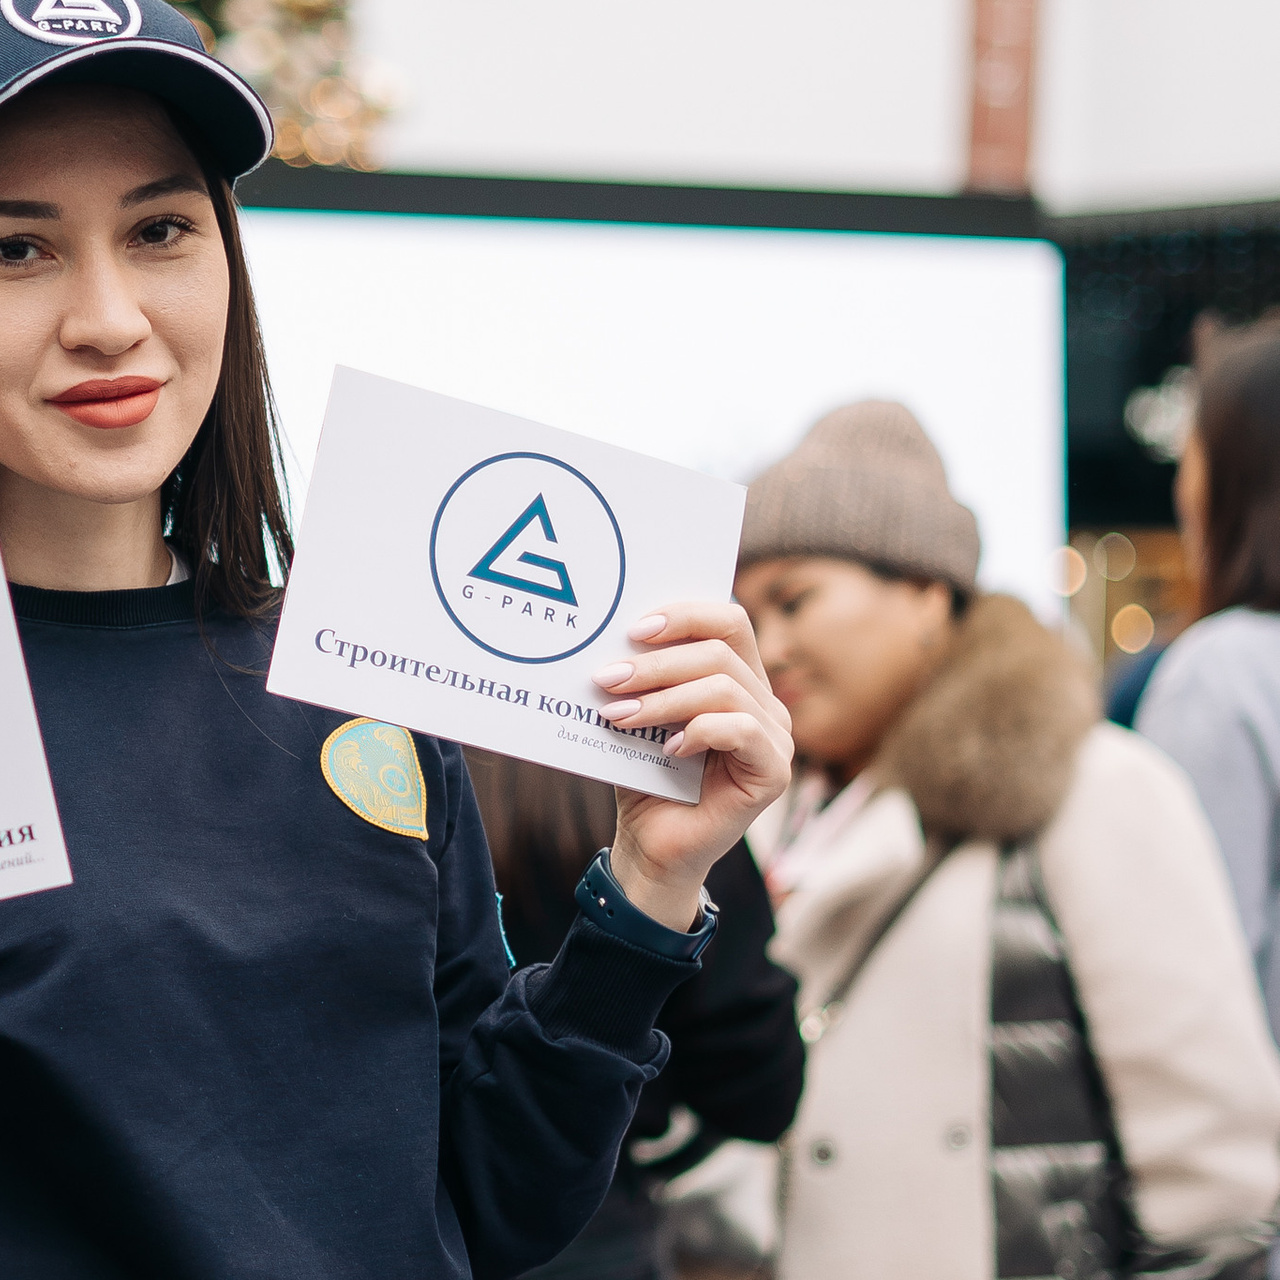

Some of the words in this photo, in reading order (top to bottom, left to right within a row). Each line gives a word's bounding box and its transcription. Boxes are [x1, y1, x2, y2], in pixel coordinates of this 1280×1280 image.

[37, 20, 118, 34] G-PARK
[462, 584, 578, 629] G-PARK
[314, 628, 532, 708] Строительная
[557, 725, 579, 742] для
[581, 736, 607, 756] всех
